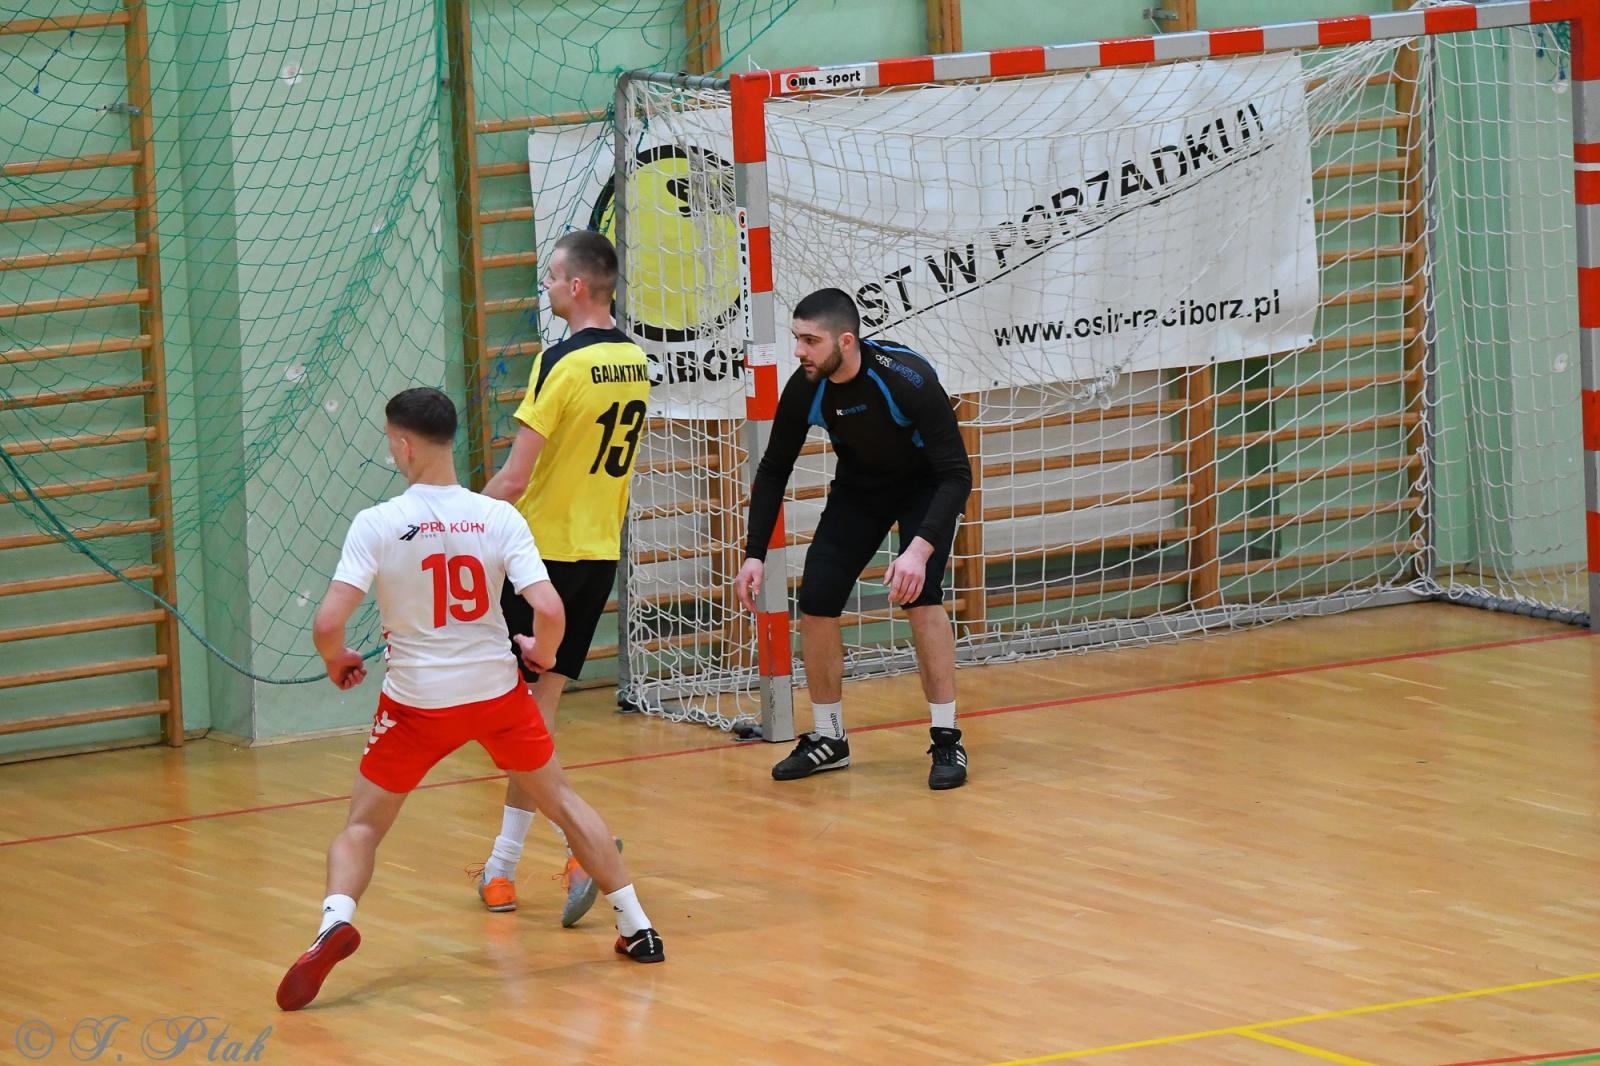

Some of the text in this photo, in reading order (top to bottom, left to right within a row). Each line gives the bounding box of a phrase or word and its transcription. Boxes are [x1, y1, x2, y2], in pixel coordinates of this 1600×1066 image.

[826, 70, 861, 87] sport
[856, 264, 913, 328] ST
[924, 242, 978, 294] W
[994, 289, 1281, 347] www.osir-raciborz.pl
[589, 400, 647, 478] 13
[450, 520, 485, 534] KÜHN
[421, 553, 490, 629] 19
